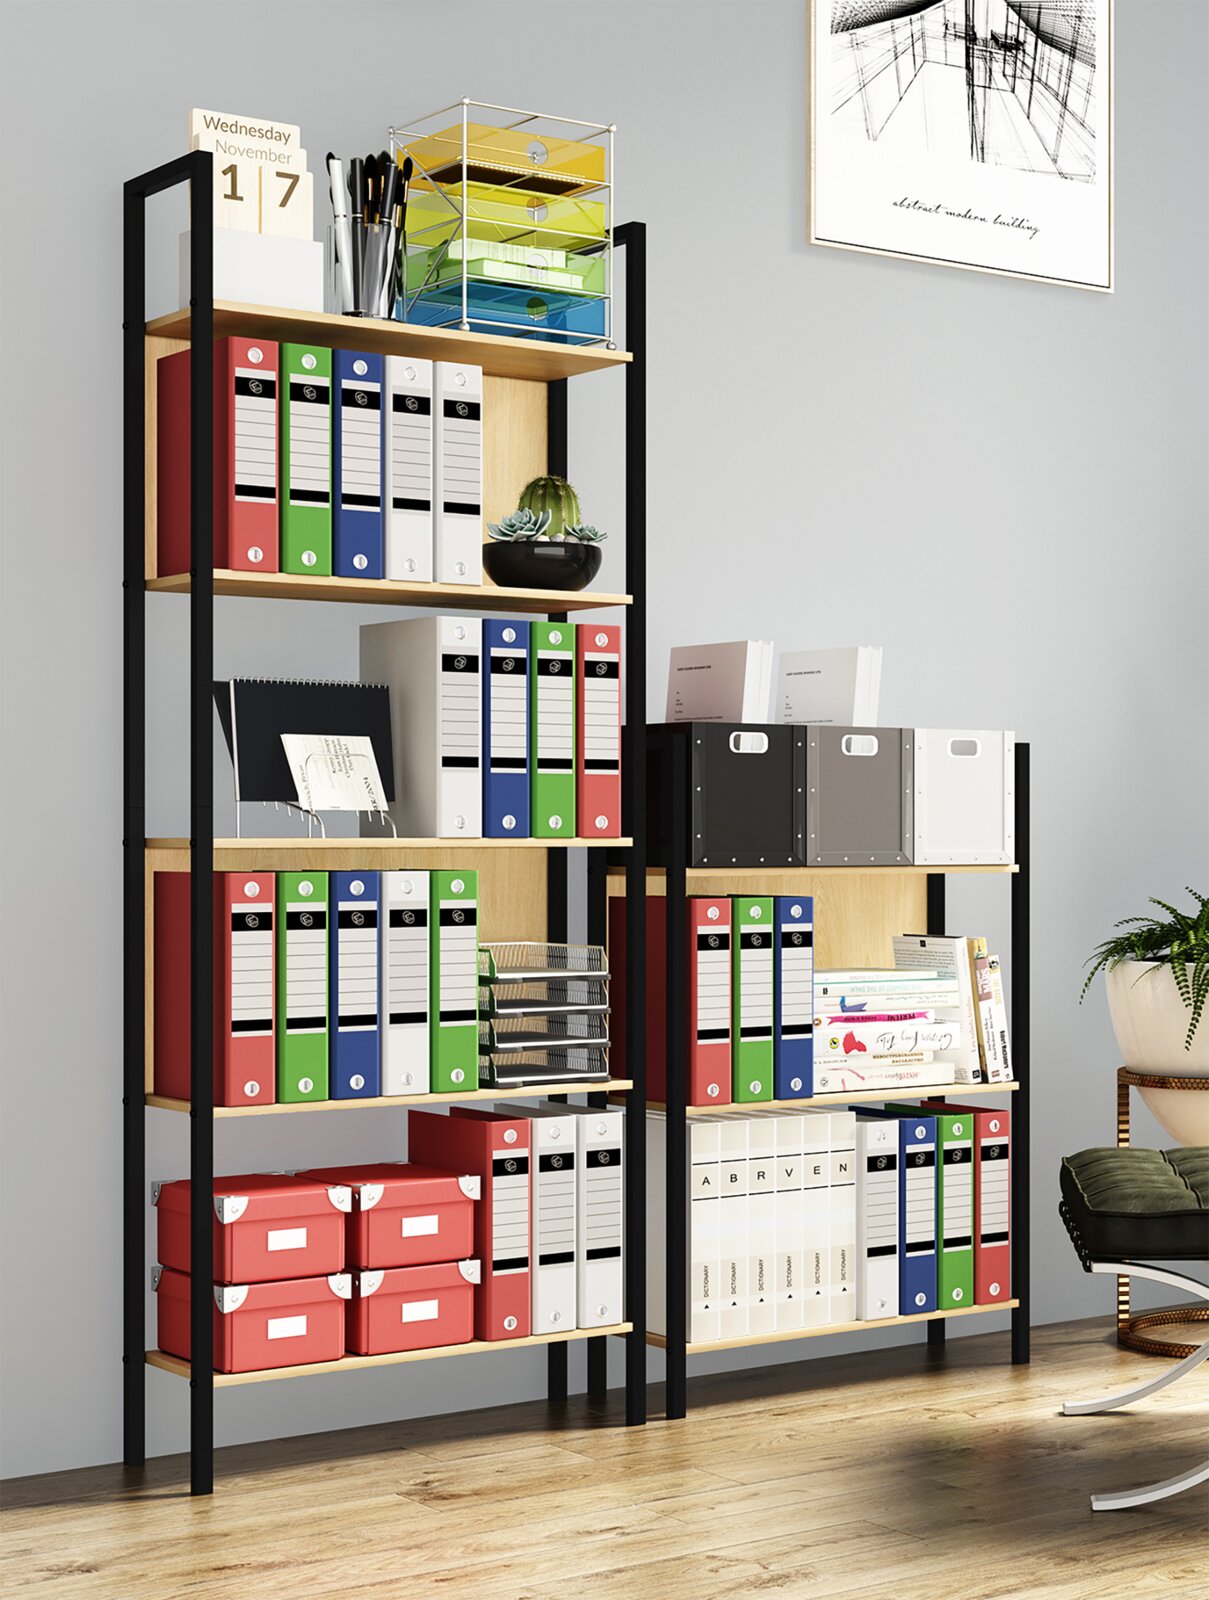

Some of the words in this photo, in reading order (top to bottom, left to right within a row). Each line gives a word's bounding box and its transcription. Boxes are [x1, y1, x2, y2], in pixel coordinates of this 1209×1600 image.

[203, 115, 291, 146] Wednesday
[215, 139, 292, 164] November
[221, 164, 244, 202] 1
[276, 171, 300, 208] 7
[892, 197, 945, 215] abstract
[945, 208, 988, 223] modern
[993, 214, 1041, 240] building
[785, 1168, 794, 1177] V
[813, 1165, 821, 1175] E
[839, 1163, 848, 1172] N
[729, 1173, 738, 1183] B
[757, 1171, 766, 1180] R
[701, 1176, 711, 1186] A
